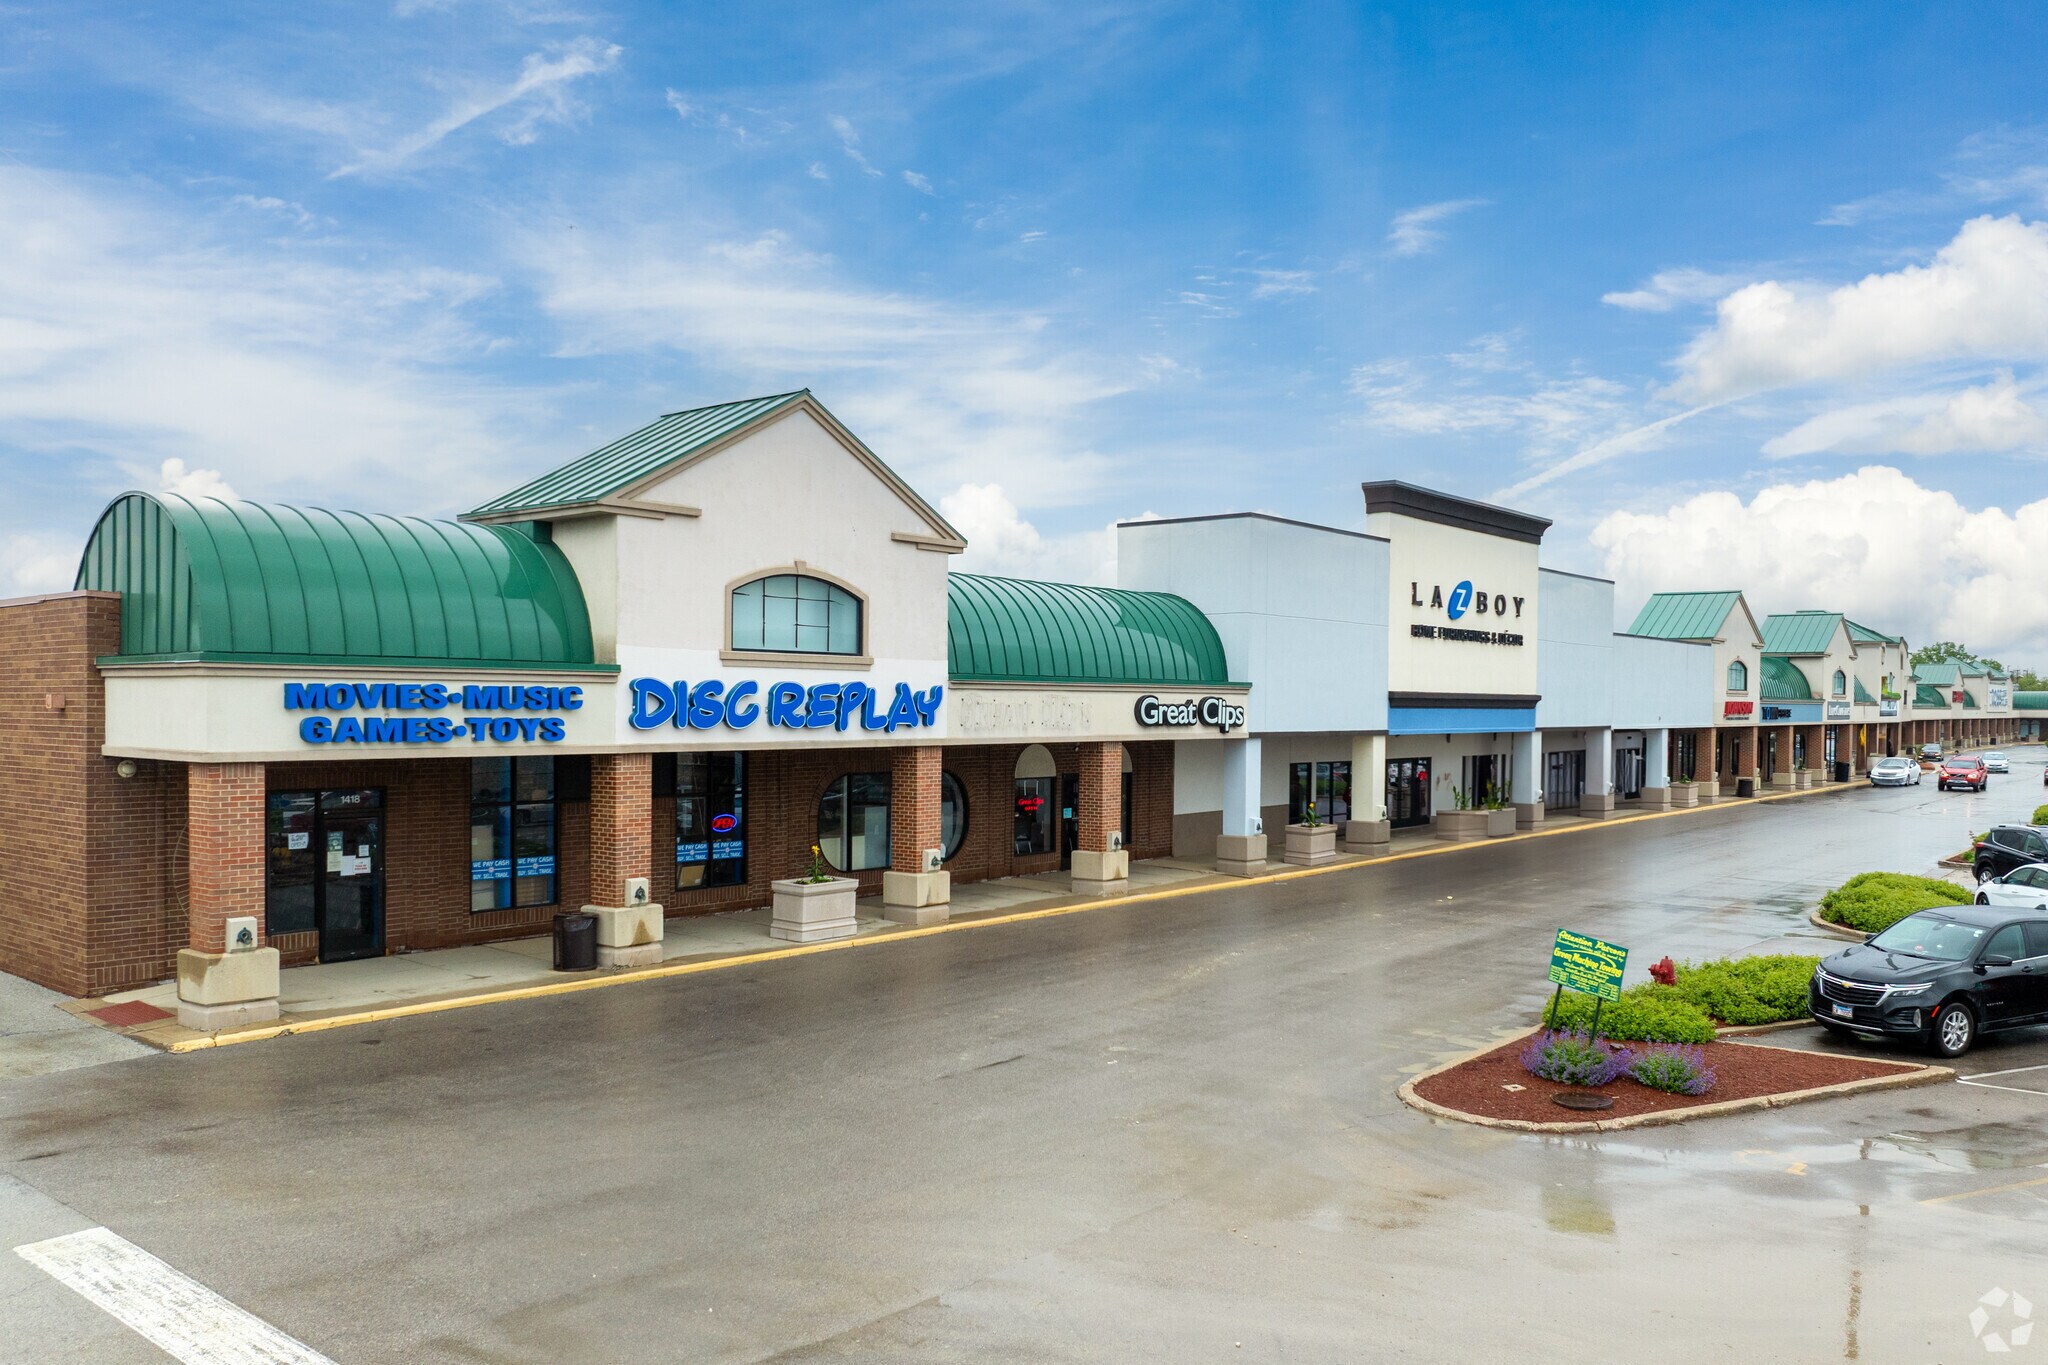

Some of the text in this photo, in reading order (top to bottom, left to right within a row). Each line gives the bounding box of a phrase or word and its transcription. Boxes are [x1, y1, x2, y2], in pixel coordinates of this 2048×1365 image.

[1410, 624, 1437, 638] HOME
[629, 677, 944, 734] DISC REPLAY
[1135, 694, 1245, 734] Great Clips
[340, 795, 361, 804] 1418
[712, 818, 735, 829] OPEN
[1557, 931, 1593, 947] Attention
[1595, 941, 1626, 957] Patrons
[1554, 948, 1573, 962] Green
[1572, 953, 1599, 969] Machine
[1599, 961, 1623, 978] Towing
